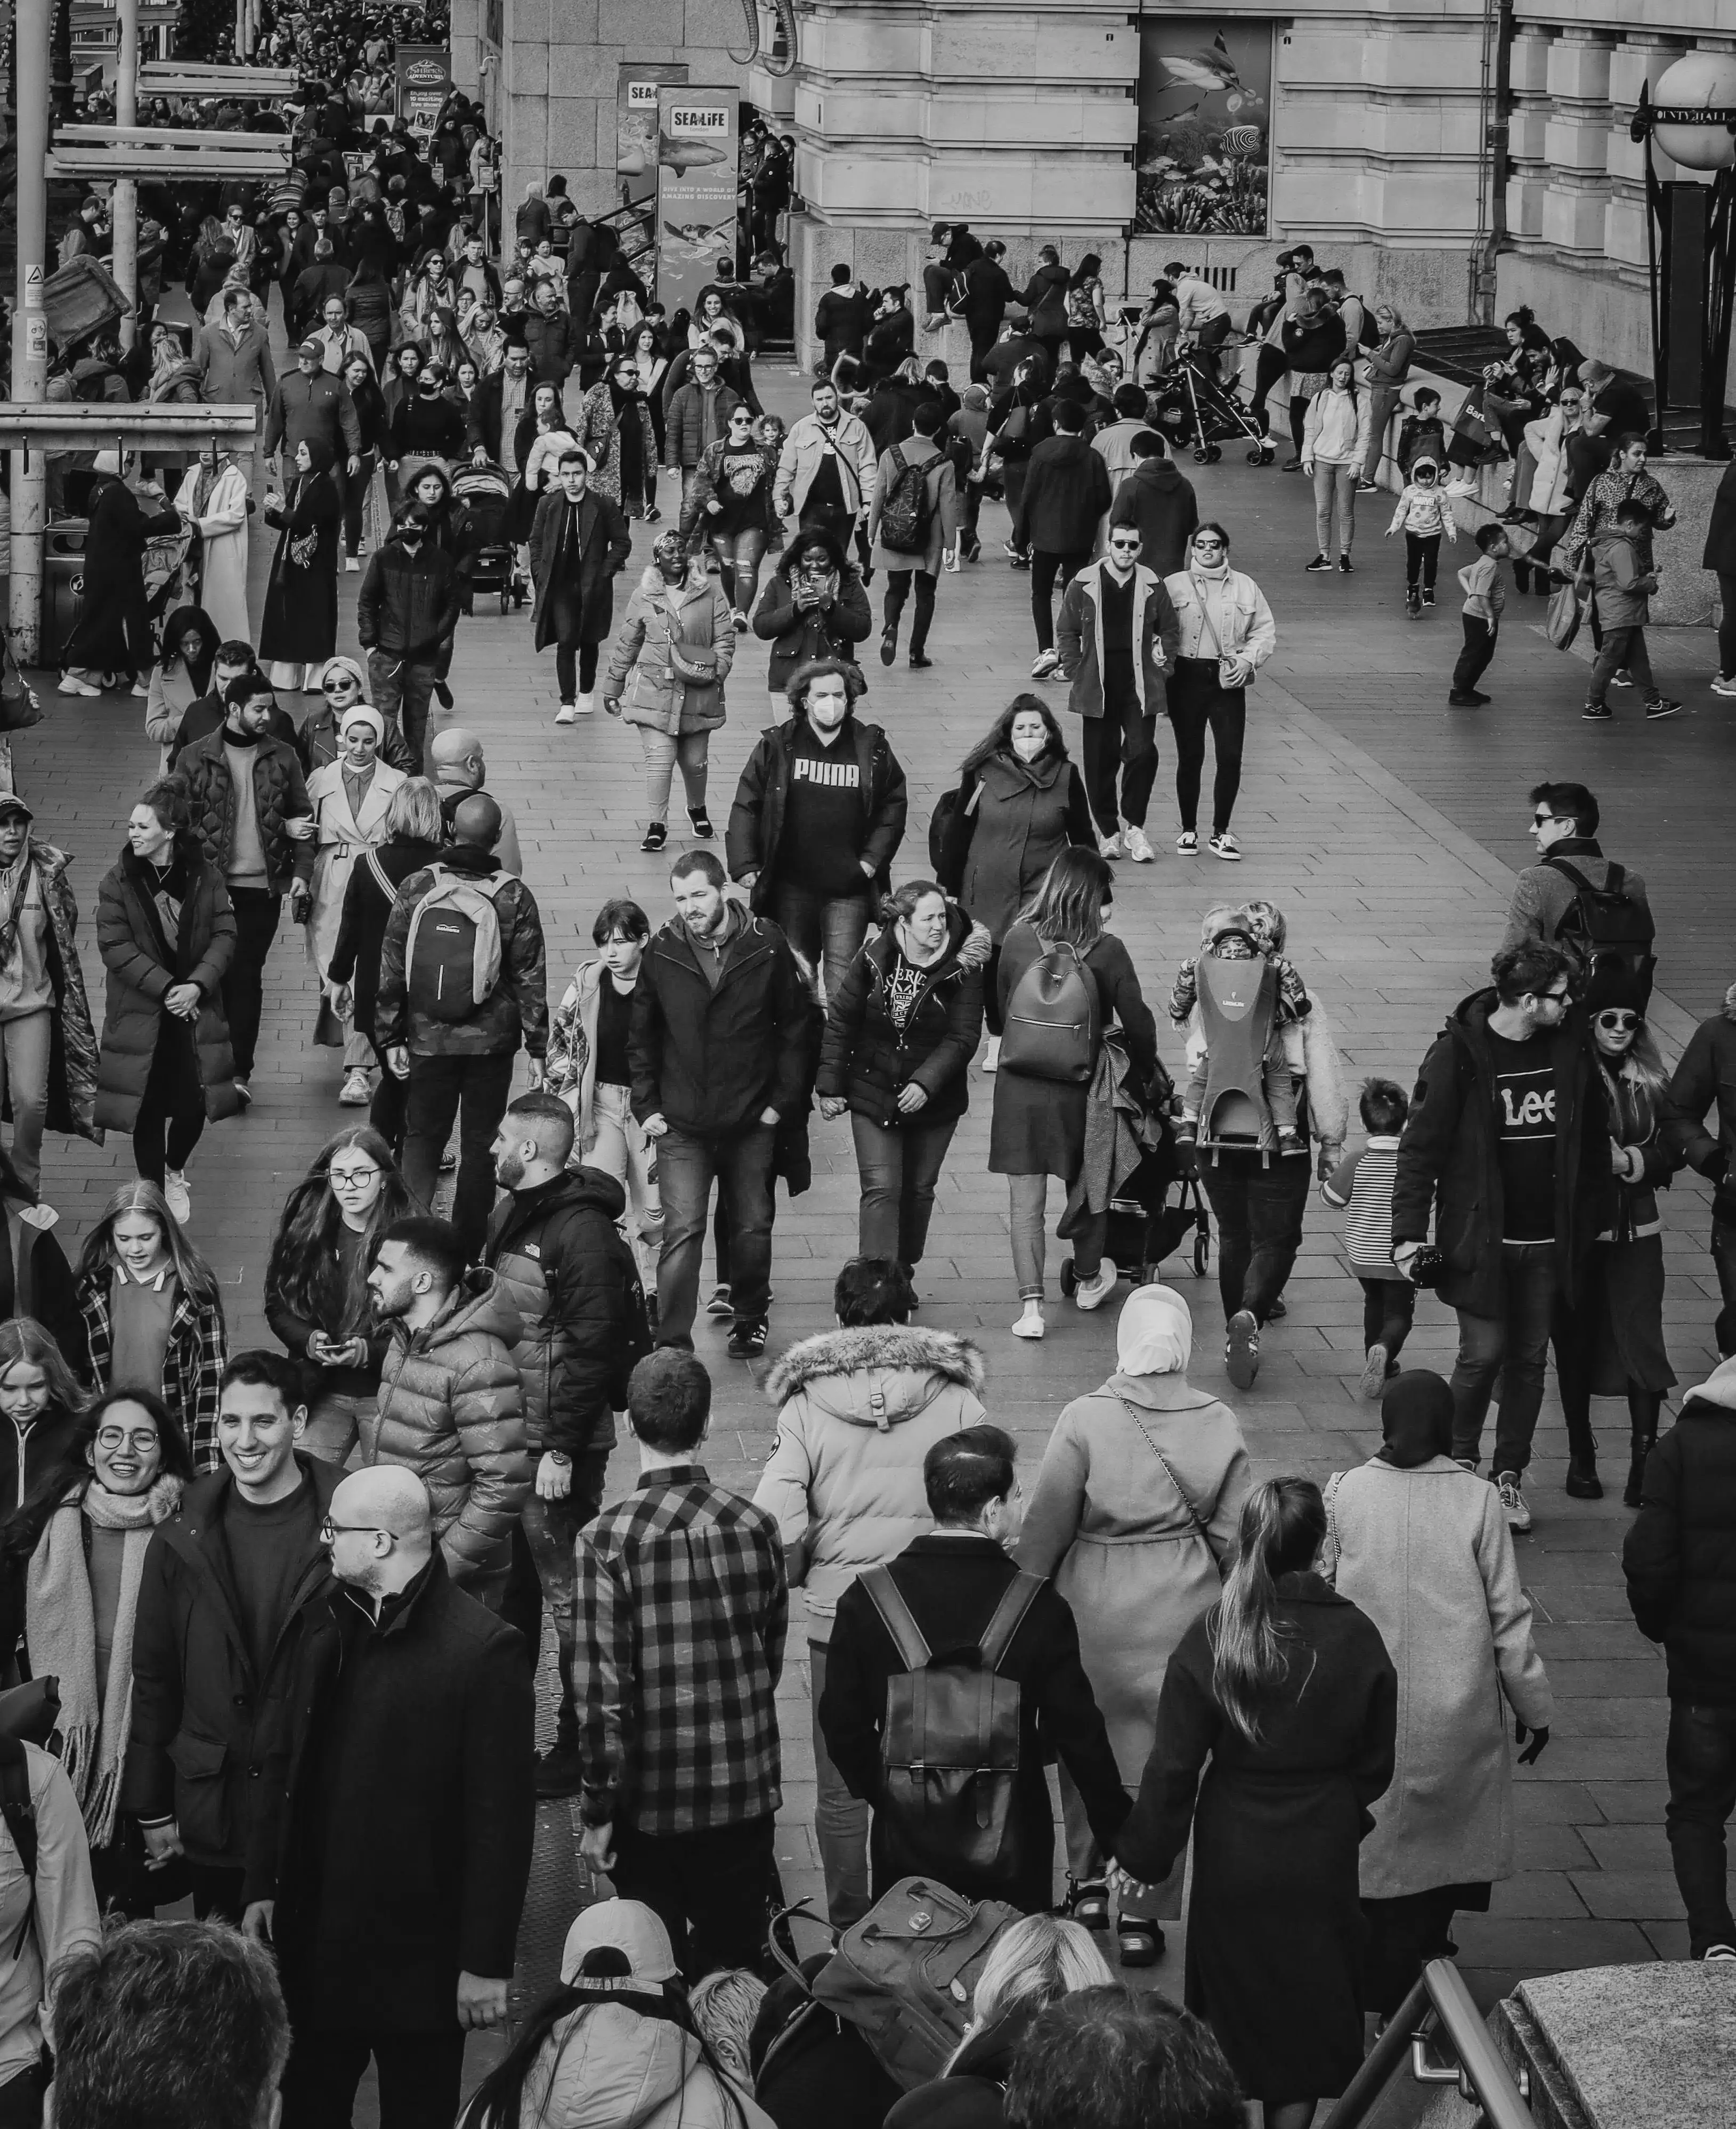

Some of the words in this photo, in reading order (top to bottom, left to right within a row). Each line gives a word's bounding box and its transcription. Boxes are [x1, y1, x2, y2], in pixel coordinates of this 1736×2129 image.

[631, 87, 652, 99] SEA
[675, 112, 698, 126] SEA
[1413, 495, 1435, 506] MARVEL
[793, 758, 859, 788] PUMA
[1500, 1088, 1556, 1126] Lee
